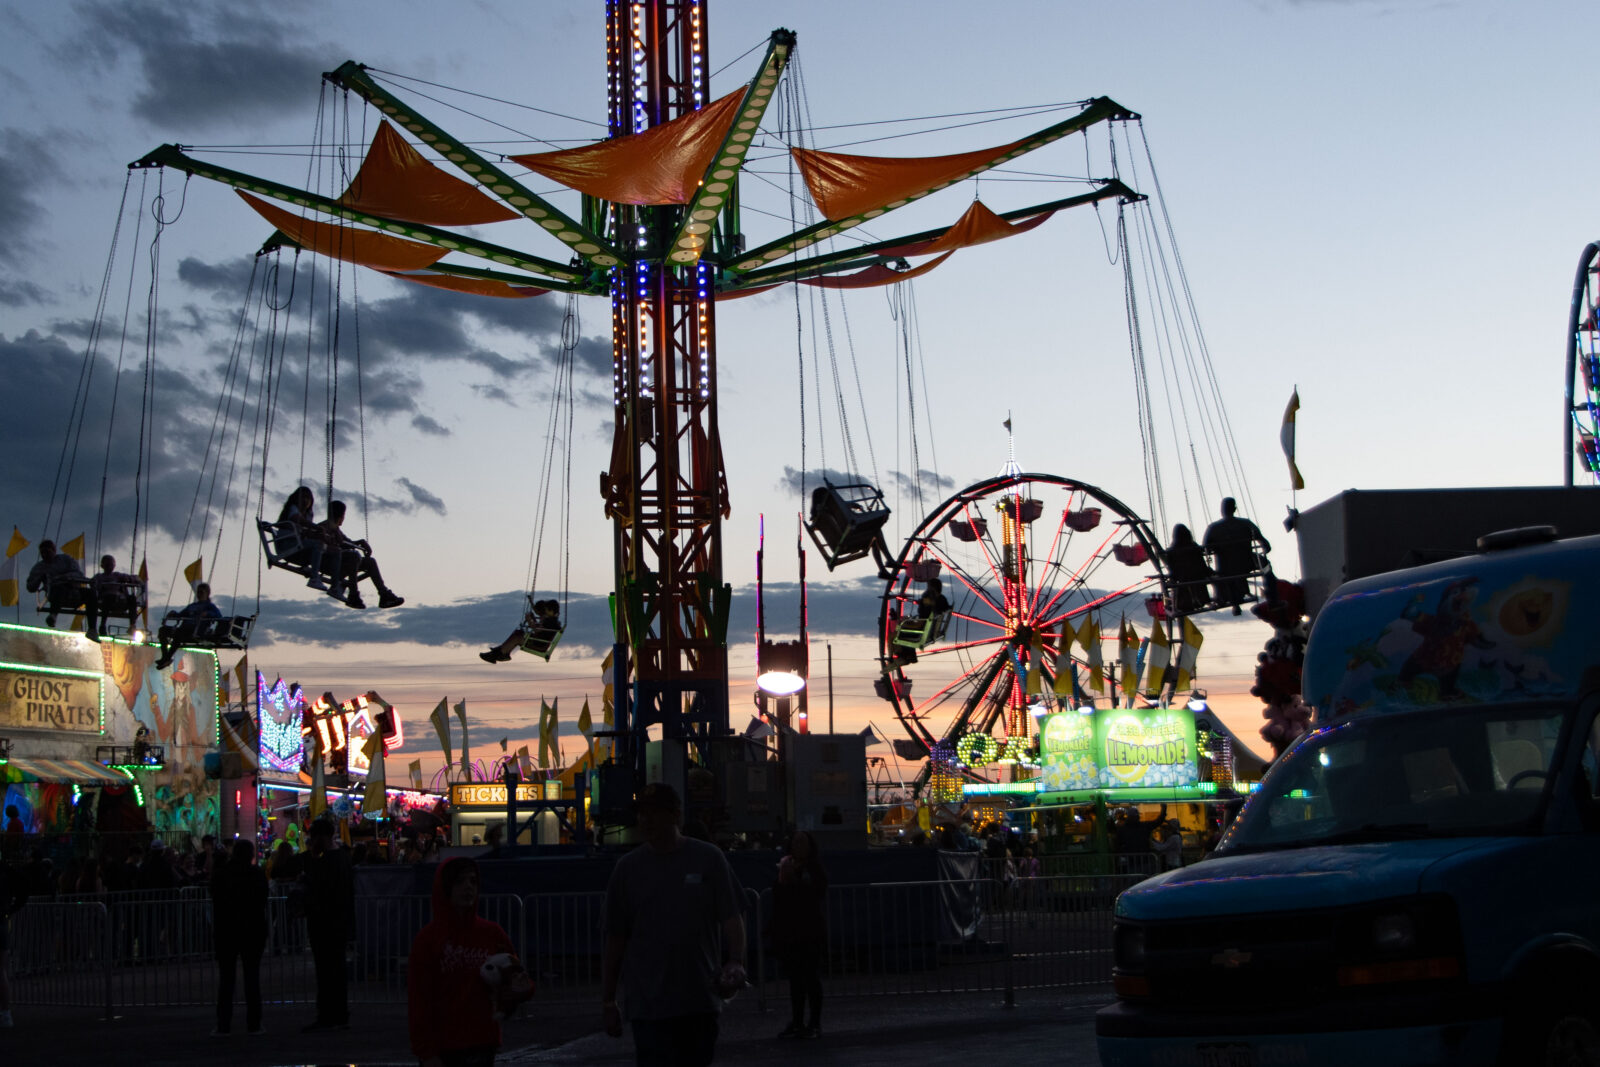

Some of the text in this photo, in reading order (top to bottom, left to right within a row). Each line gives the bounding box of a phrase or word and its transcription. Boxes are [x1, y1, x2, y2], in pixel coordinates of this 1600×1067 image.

[14, 677, 72, 702] GHOST
[26, 702, 95, 730] PIRATES
[1048, 735, 1089, 752] LEMONADE
[1107, 738, 1185, 765] LEMONADE
[457, 786, 538, 802] TICKTS
